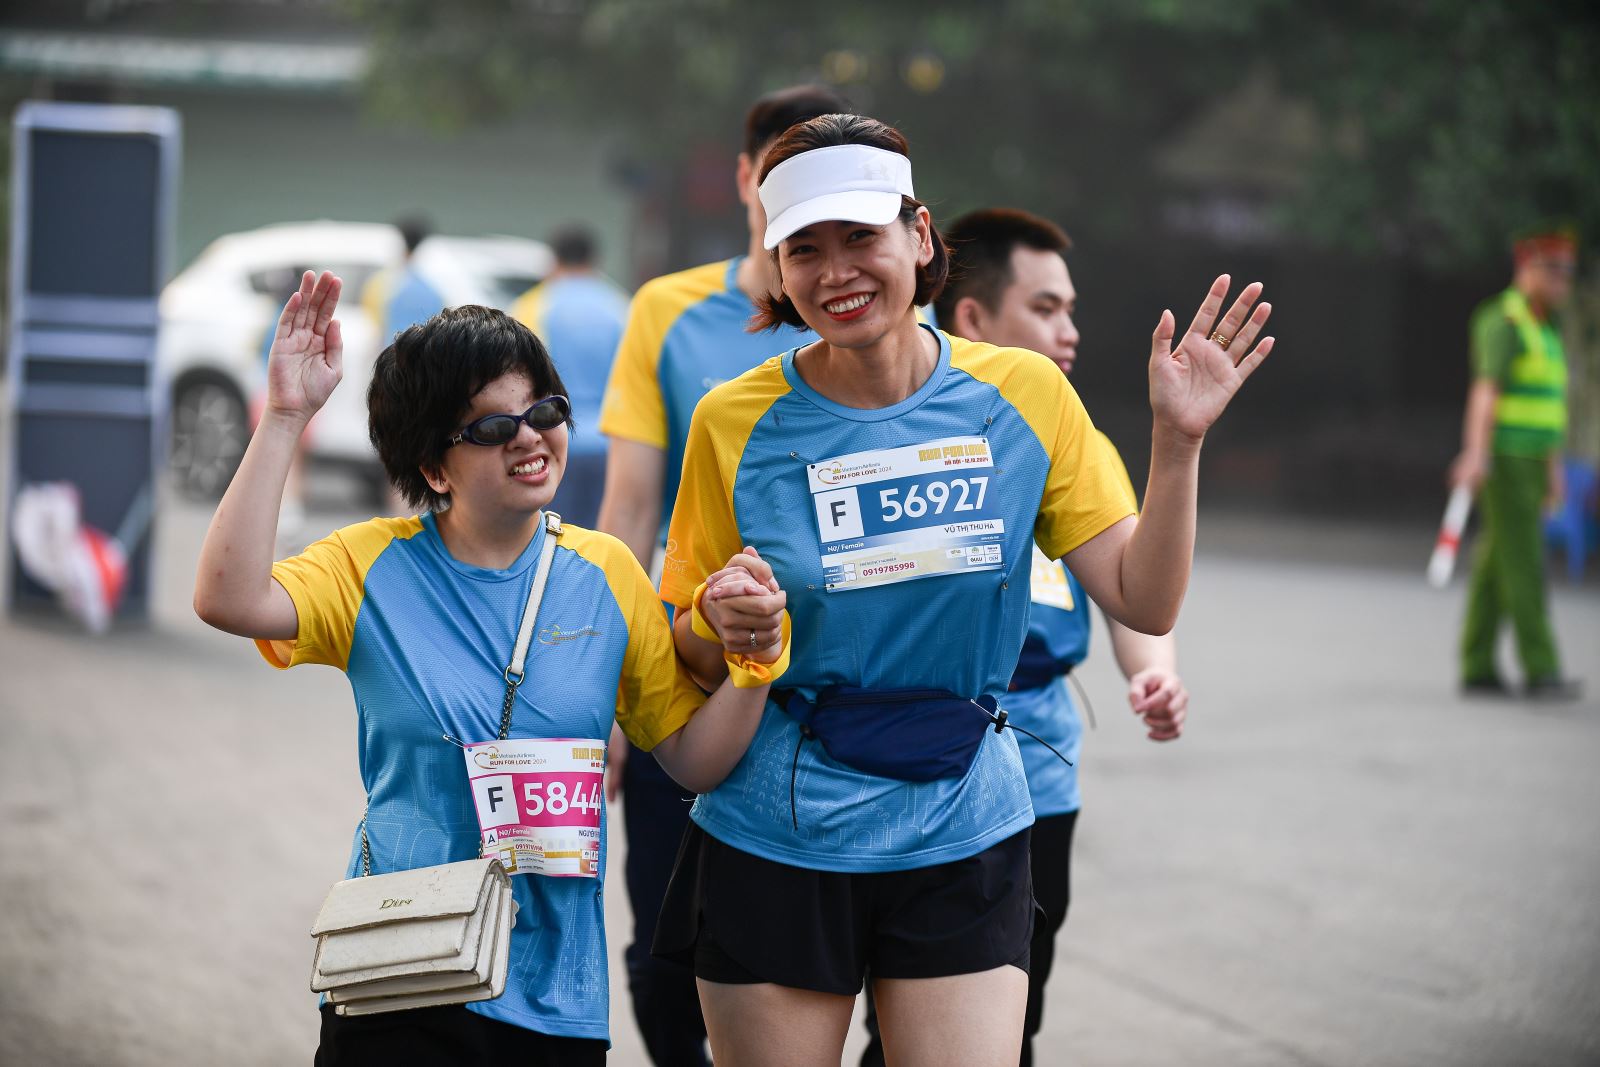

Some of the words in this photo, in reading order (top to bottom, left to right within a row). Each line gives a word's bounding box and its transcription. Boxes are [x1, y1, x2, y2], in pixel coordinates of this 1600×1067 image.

[832, 473, 847, 481] RUN
[879, 476, 989, 522] 56927
[830, 500, 847, 528] F
[969, 523, 983, 531] THU
[841, 542, 865, 551] Female
[862, 561, 915, 577] 0919785998
[487, 785, 504, 813] F
[523, 781, 603, 816] 5844
[488, 833, 496, 845] A
